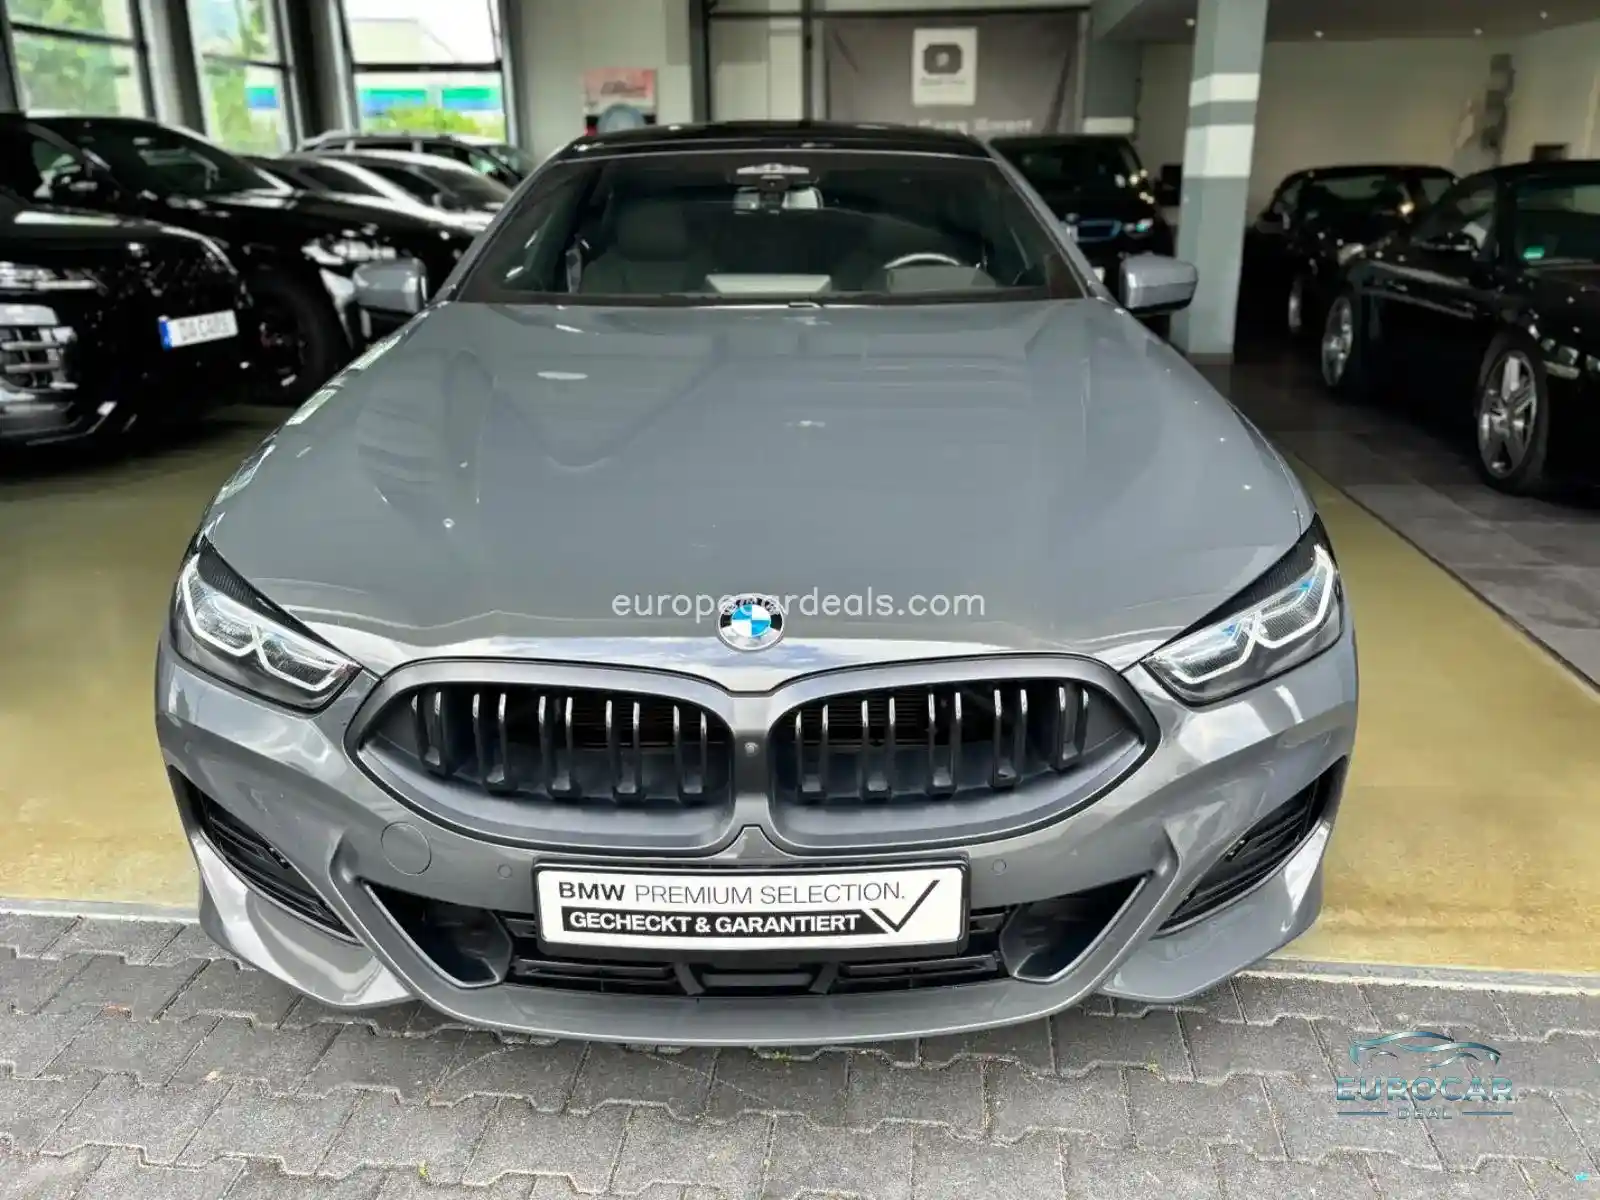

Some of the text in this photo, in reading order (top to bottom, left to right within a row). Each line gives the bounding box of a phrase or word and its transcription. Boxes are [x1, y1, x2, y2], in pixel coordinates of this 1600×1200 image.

[558, 881, 905, 905] BMW PREMIUM SELECTION.
[569, 911, 861, 933] GECHECKT & GARANTIERT
